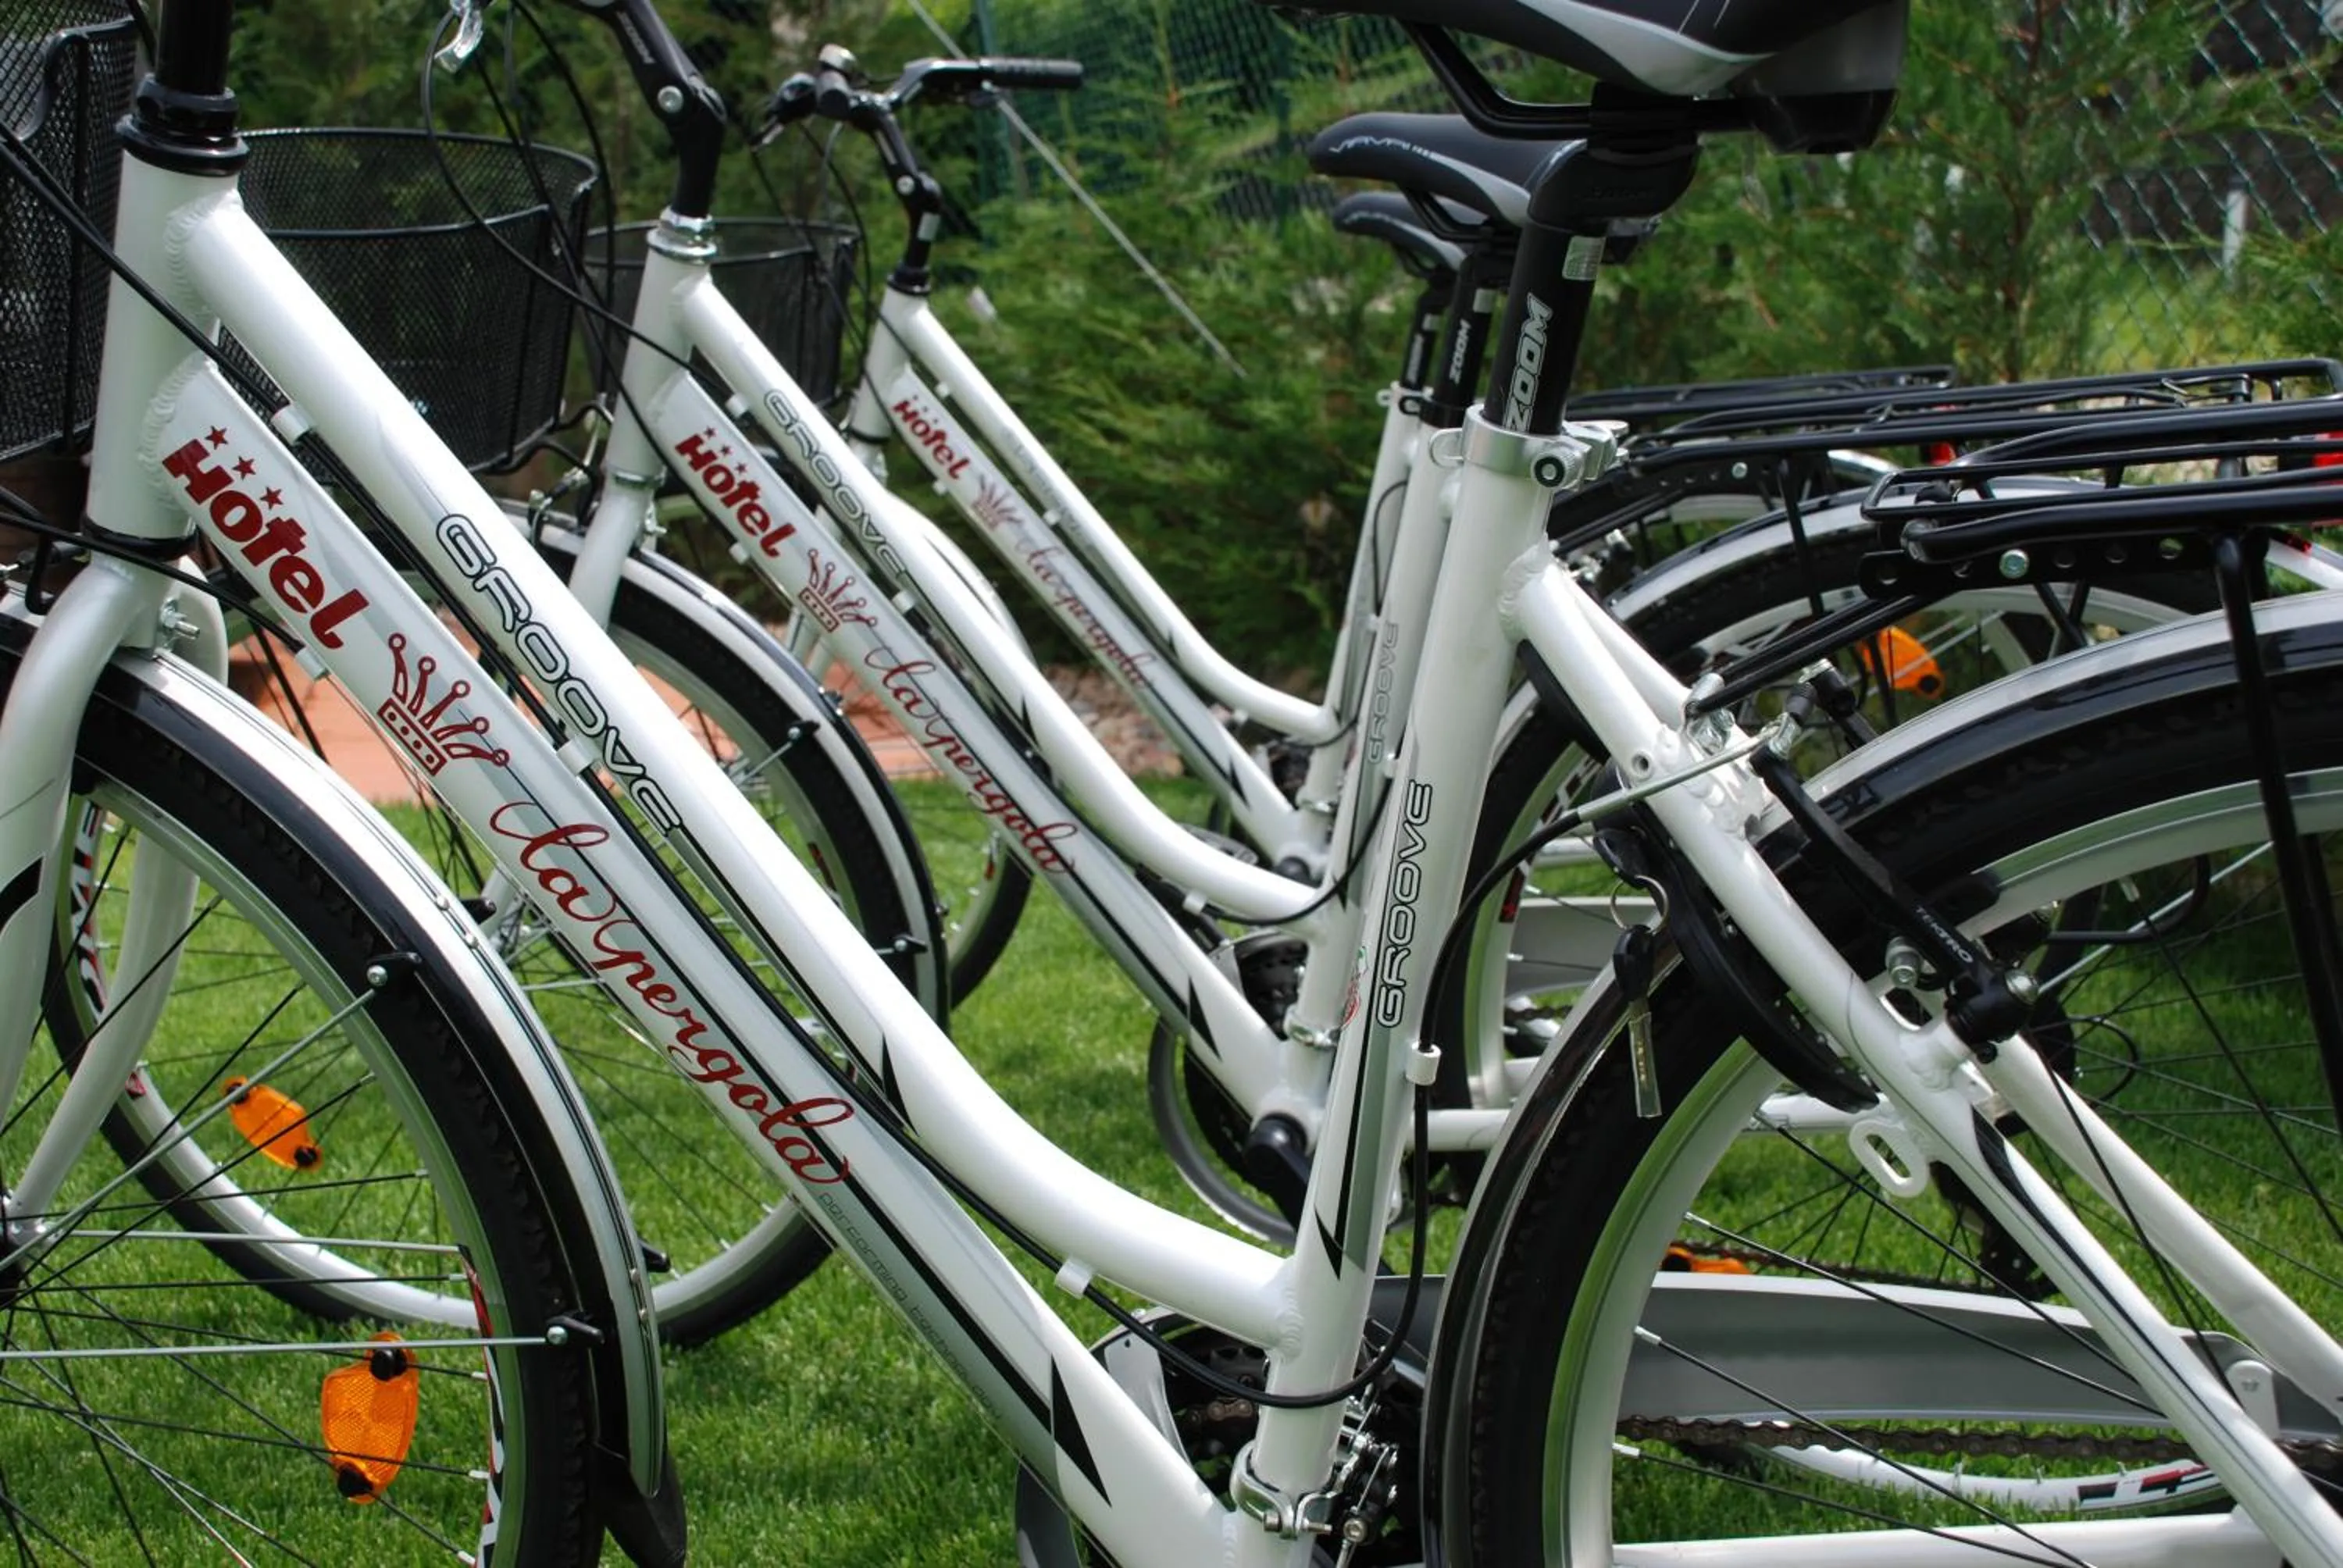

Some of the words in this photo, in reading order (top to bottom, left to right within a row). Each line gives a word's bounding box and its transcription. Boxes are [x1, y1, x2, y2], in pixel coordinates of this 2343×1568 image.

[1449, 319, 1472, 386] ZOOM
[1503, 292, 1553, 432] ZOOM
[675, 433, 797, 558] Hotel
[764, 390, 906, 577] GROOVE
[893, 400, 970, 479] Hotel
[162, 438, 369, 649] Hotel
[437, 514, 683, 838] GROOVE
[1368, 622, 1398, 764] GROOVE
[1376, 779, 1432, 1028] GROOVE
